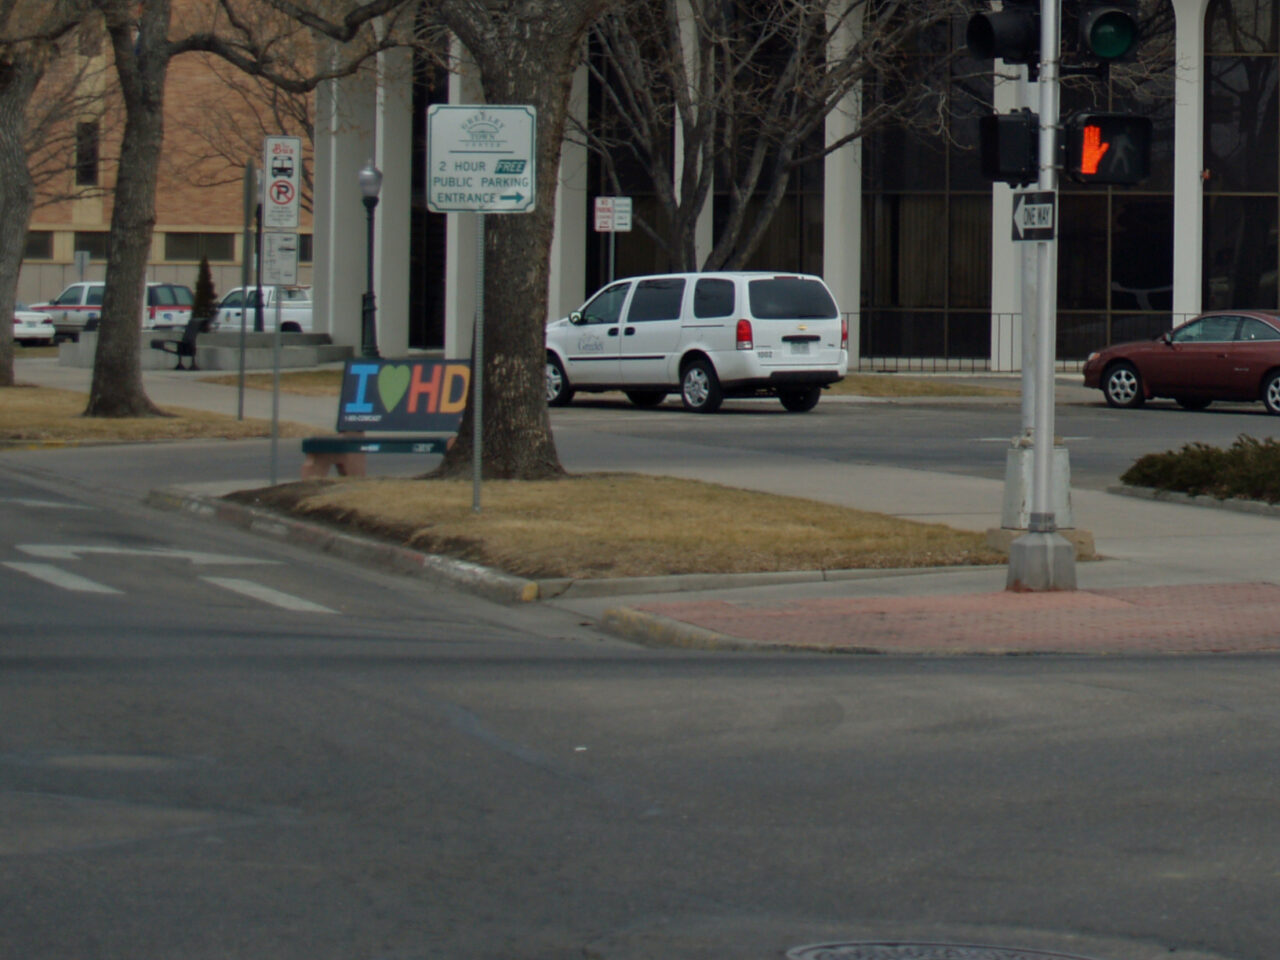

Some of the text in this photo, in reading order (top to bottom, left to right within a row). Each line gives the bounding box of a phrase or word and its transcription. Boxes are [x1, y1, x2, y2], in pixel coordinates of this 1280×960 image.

[439, 161, 525, 172] 2 HOUR FREE
[433, 176, 530, 188] PUBLIC PARKING
[437, 192, 497, 204] ENTRANCE
[1024, 206, 1049, 226] ONE WAY
[345, 364, 471, 414] I HD
